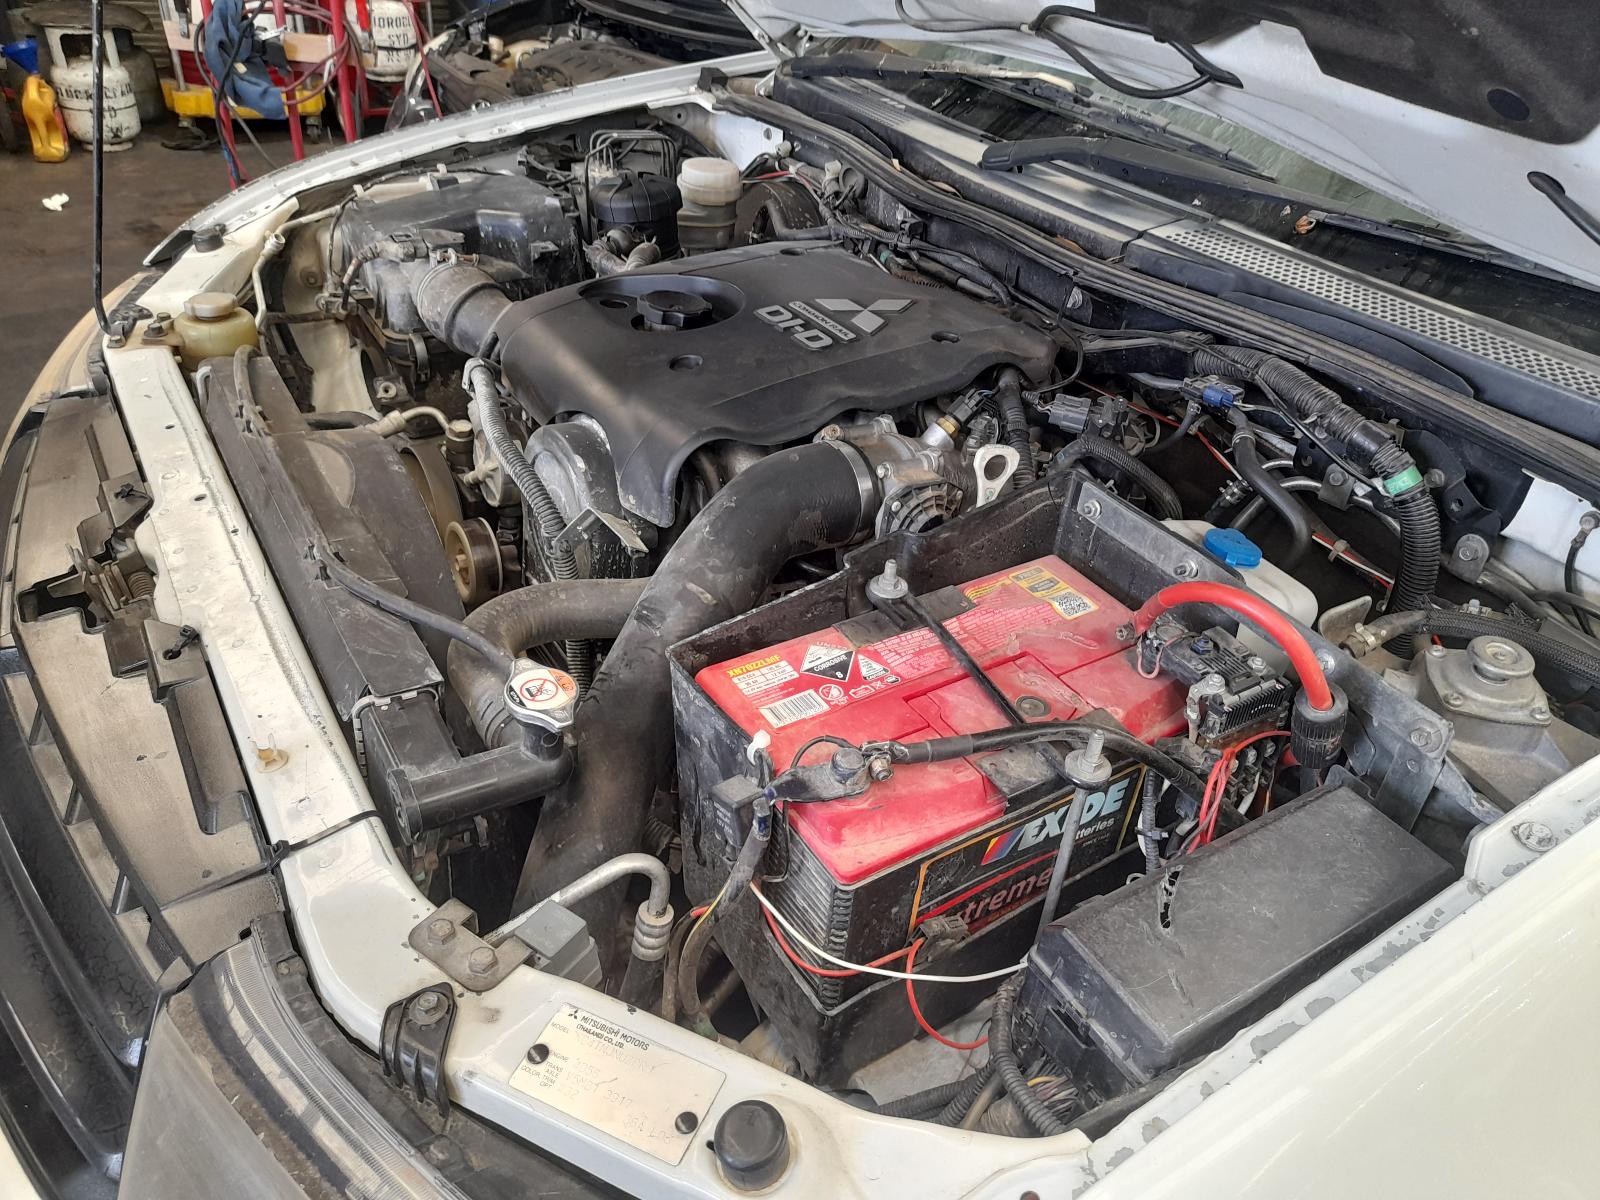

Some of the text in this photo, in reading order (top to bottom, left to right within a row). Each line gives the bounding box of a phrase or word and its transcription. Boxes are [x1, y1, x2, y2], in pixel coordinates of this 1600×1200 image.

[828, 323, 849, 338] RAIL
[813, 655, 848, 672] CORROSIVE
[835, 671, 844, 679] 8
[1018, 778, 1130, 851] EXDE
[1075, 818, 1115, 840] tteries
[962, 869, 1053, 923] treme
[551, 1022, 569, 1033] MODEL
[576, 1024, 603, 1039] (THAILAND)
[580, 1016, 650, 1051] MITSUBISHI MOTORS
[545, 1069, 559, 1078] AXLE
[539, 1081, 552, 1090] OPT
